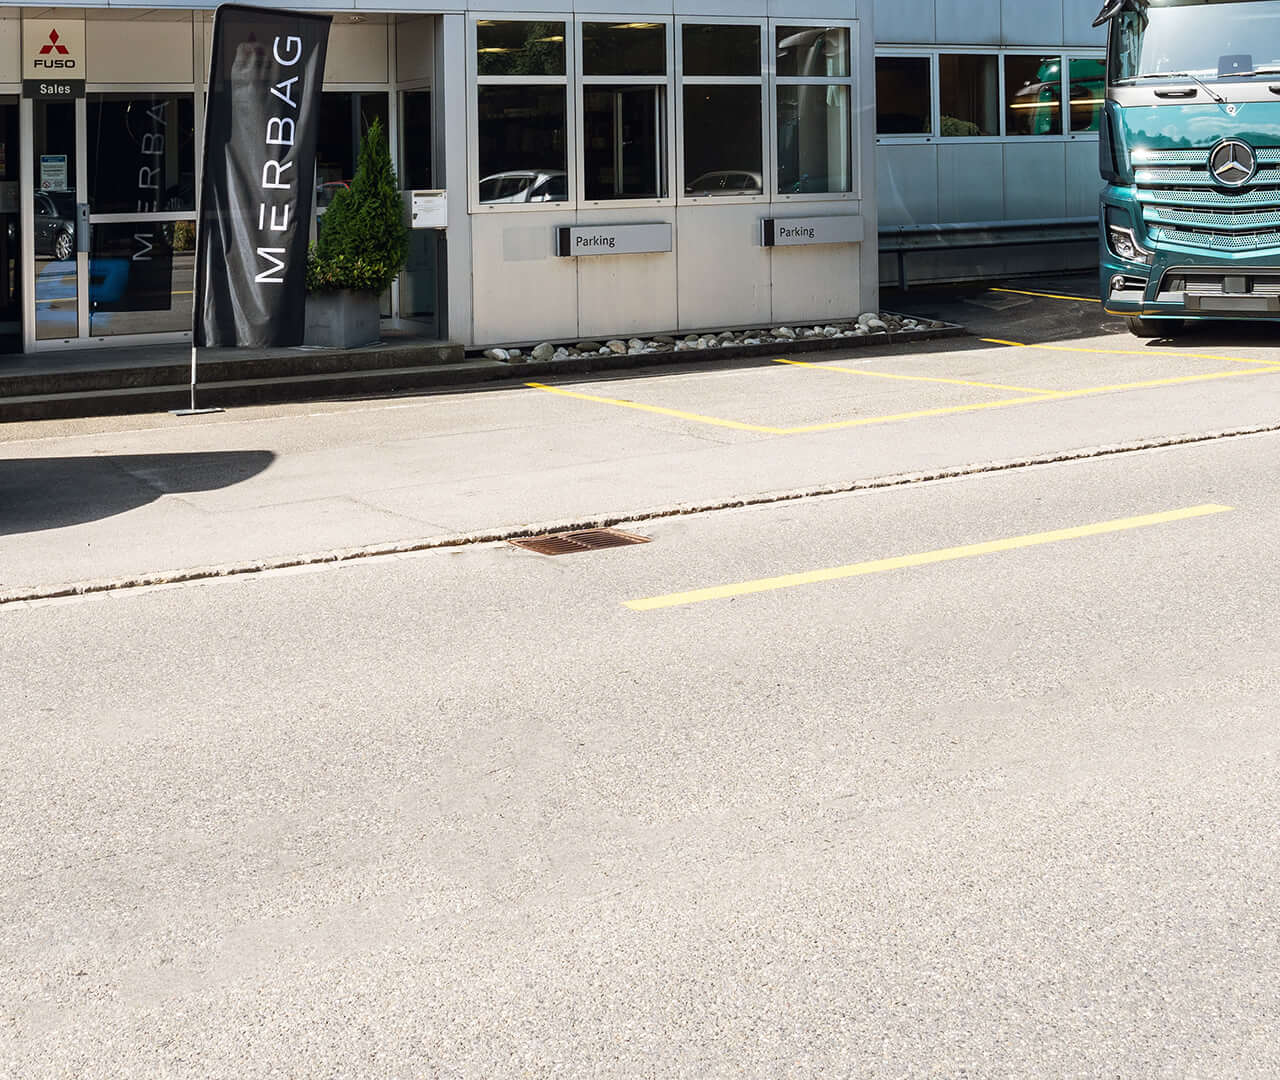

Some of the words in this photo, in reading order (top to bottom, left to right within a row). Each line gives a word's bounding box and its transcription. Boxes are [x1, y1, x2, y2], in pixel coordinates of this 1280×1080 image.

[33, 59, 76, 69] FUSO
[39, 83, 71, 95] Sales
[778, 225, 816, 239] Parking
[575, 234, 617, 249] Parking
